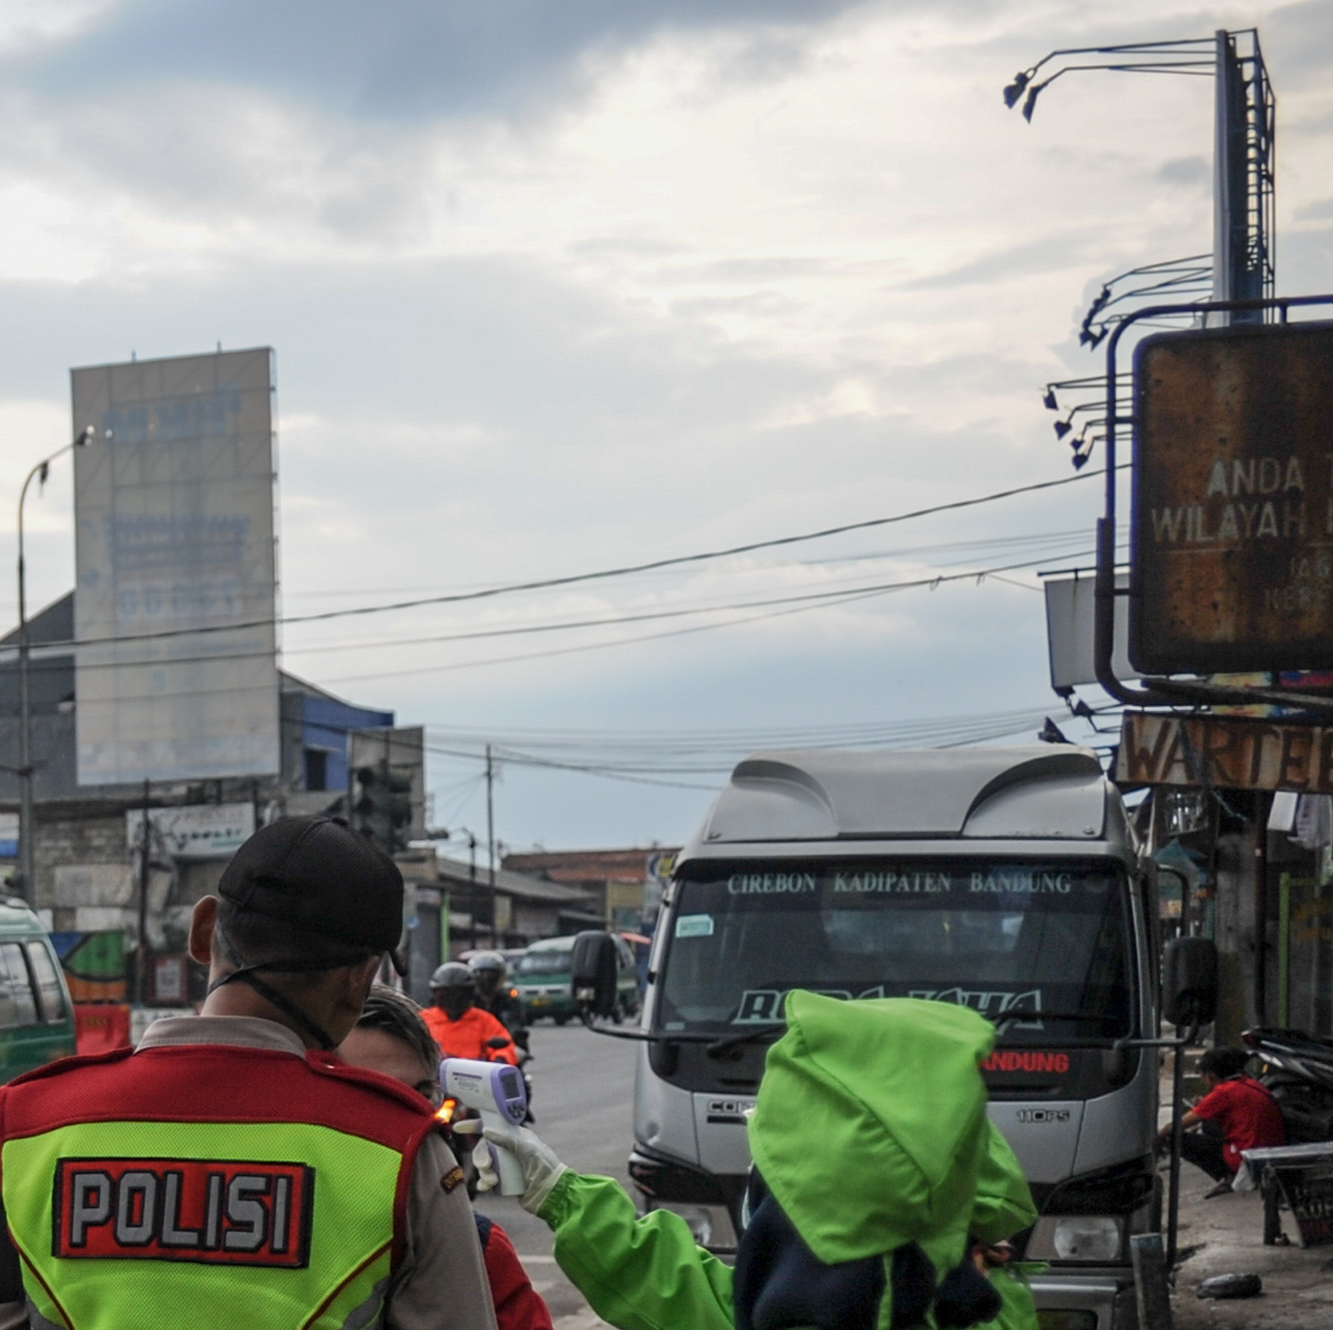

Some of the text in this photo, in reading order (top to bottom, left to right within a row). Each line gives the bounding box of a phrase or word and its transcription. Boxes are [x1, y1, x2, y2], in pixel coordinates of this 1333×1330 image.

[1207, 457, 1304, 497] ANDA
[1151, 502, 1305, 543] WILAYAH
[727, 872, 1072, 894] CIREBON KADIPATEN BANDUNG
[978, 1052, 1070, 1072] ANDUNG
[70, 1169, 293, 1254] POLISI
